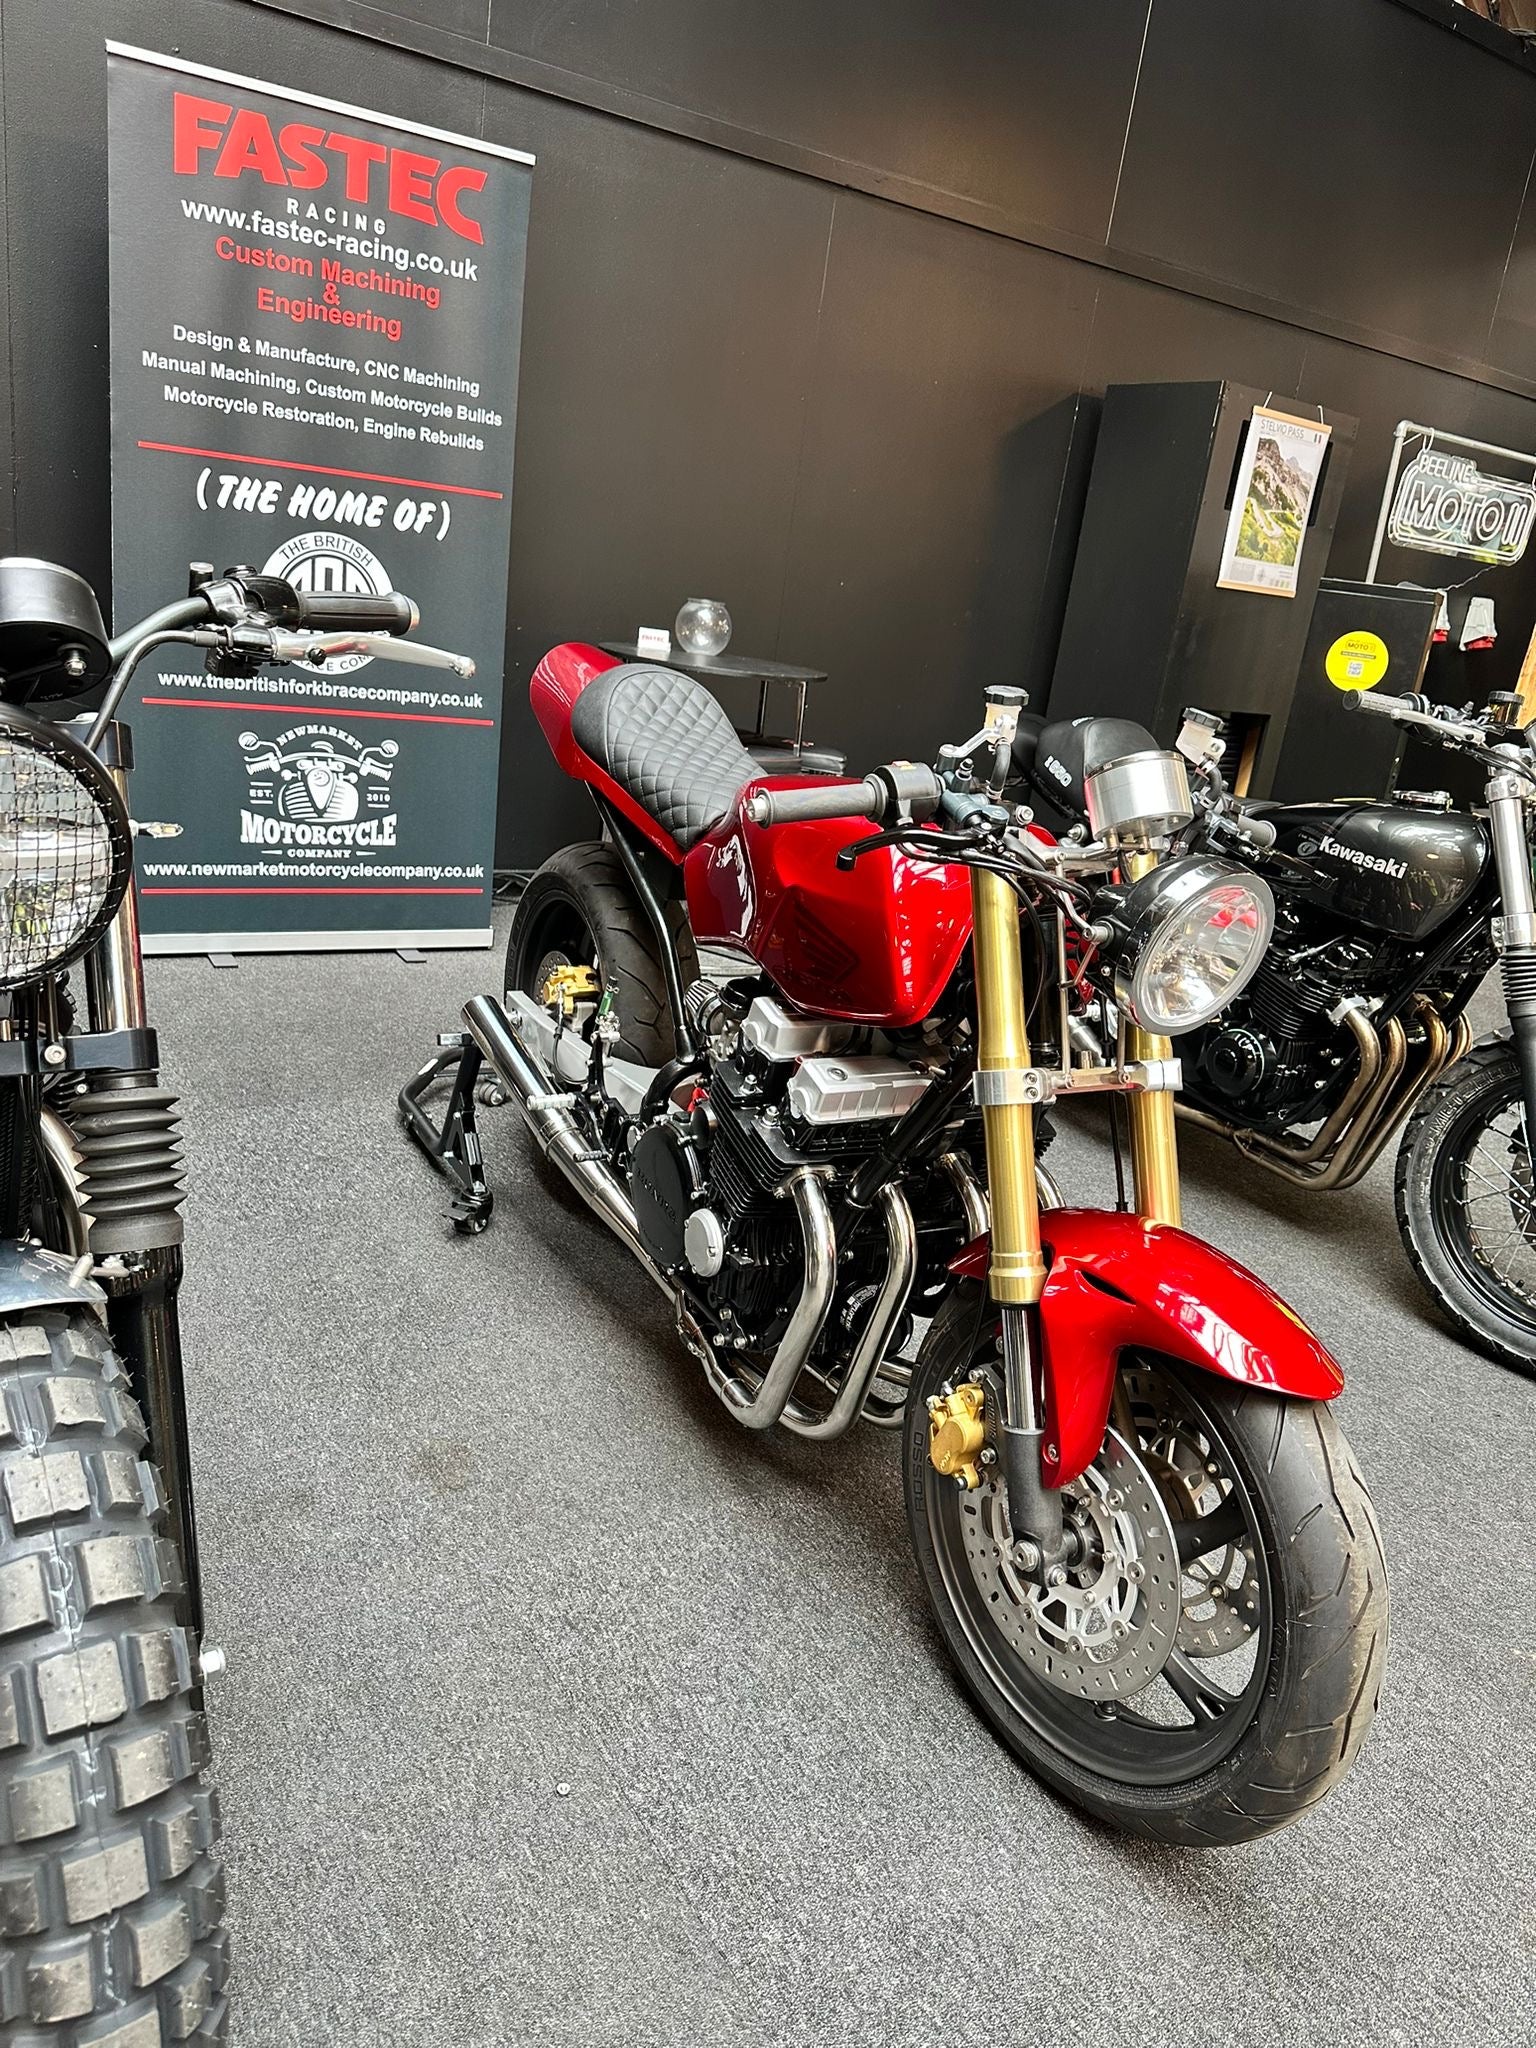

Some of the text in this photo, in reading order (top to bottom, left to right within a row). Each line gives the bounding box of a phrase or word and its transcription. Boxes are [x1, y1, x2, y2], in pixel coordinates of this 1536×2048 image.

[173, 91, 488, 245] FASTEC
[287, 197, 387, 235] RACING
[181, 199, 479, 281] www.fastec-racing.co.uk
[215, 236, 441, 309] Custom Machining
[257, 287, 403, 341] Engineering
[322, 282, 341, 306] &
[173, 324, 480, 398] Design & Manufacture, CNC Machining
[142, 350, 503, 427] Manual Machining, Custom Motorcycle Builds
[164, 385, 485, 451] Motorcycle Restoration, Engine Rebuilds
[1260, 418, 1305, 440] STELVIO PASS
[1419, 454, 1474, 484] BEELINE
[287, 483, 388, 528] HOME
[1400, 480, 1505, 542] MOTO
[279, 535, 373, 567] THE BRITISH
[275, 724, 364, 751] NEWMARKET
[249, 788, 274, 798] EST.
[240, 808, 398, 846] MOTORCYCLE
[143, 861, 485, 881] www.newmarketmotorcyclecompany.co.uk
[287, 848, 352, 859] COMPANY
[1319, 835, 1409, 880] Kawasaki
